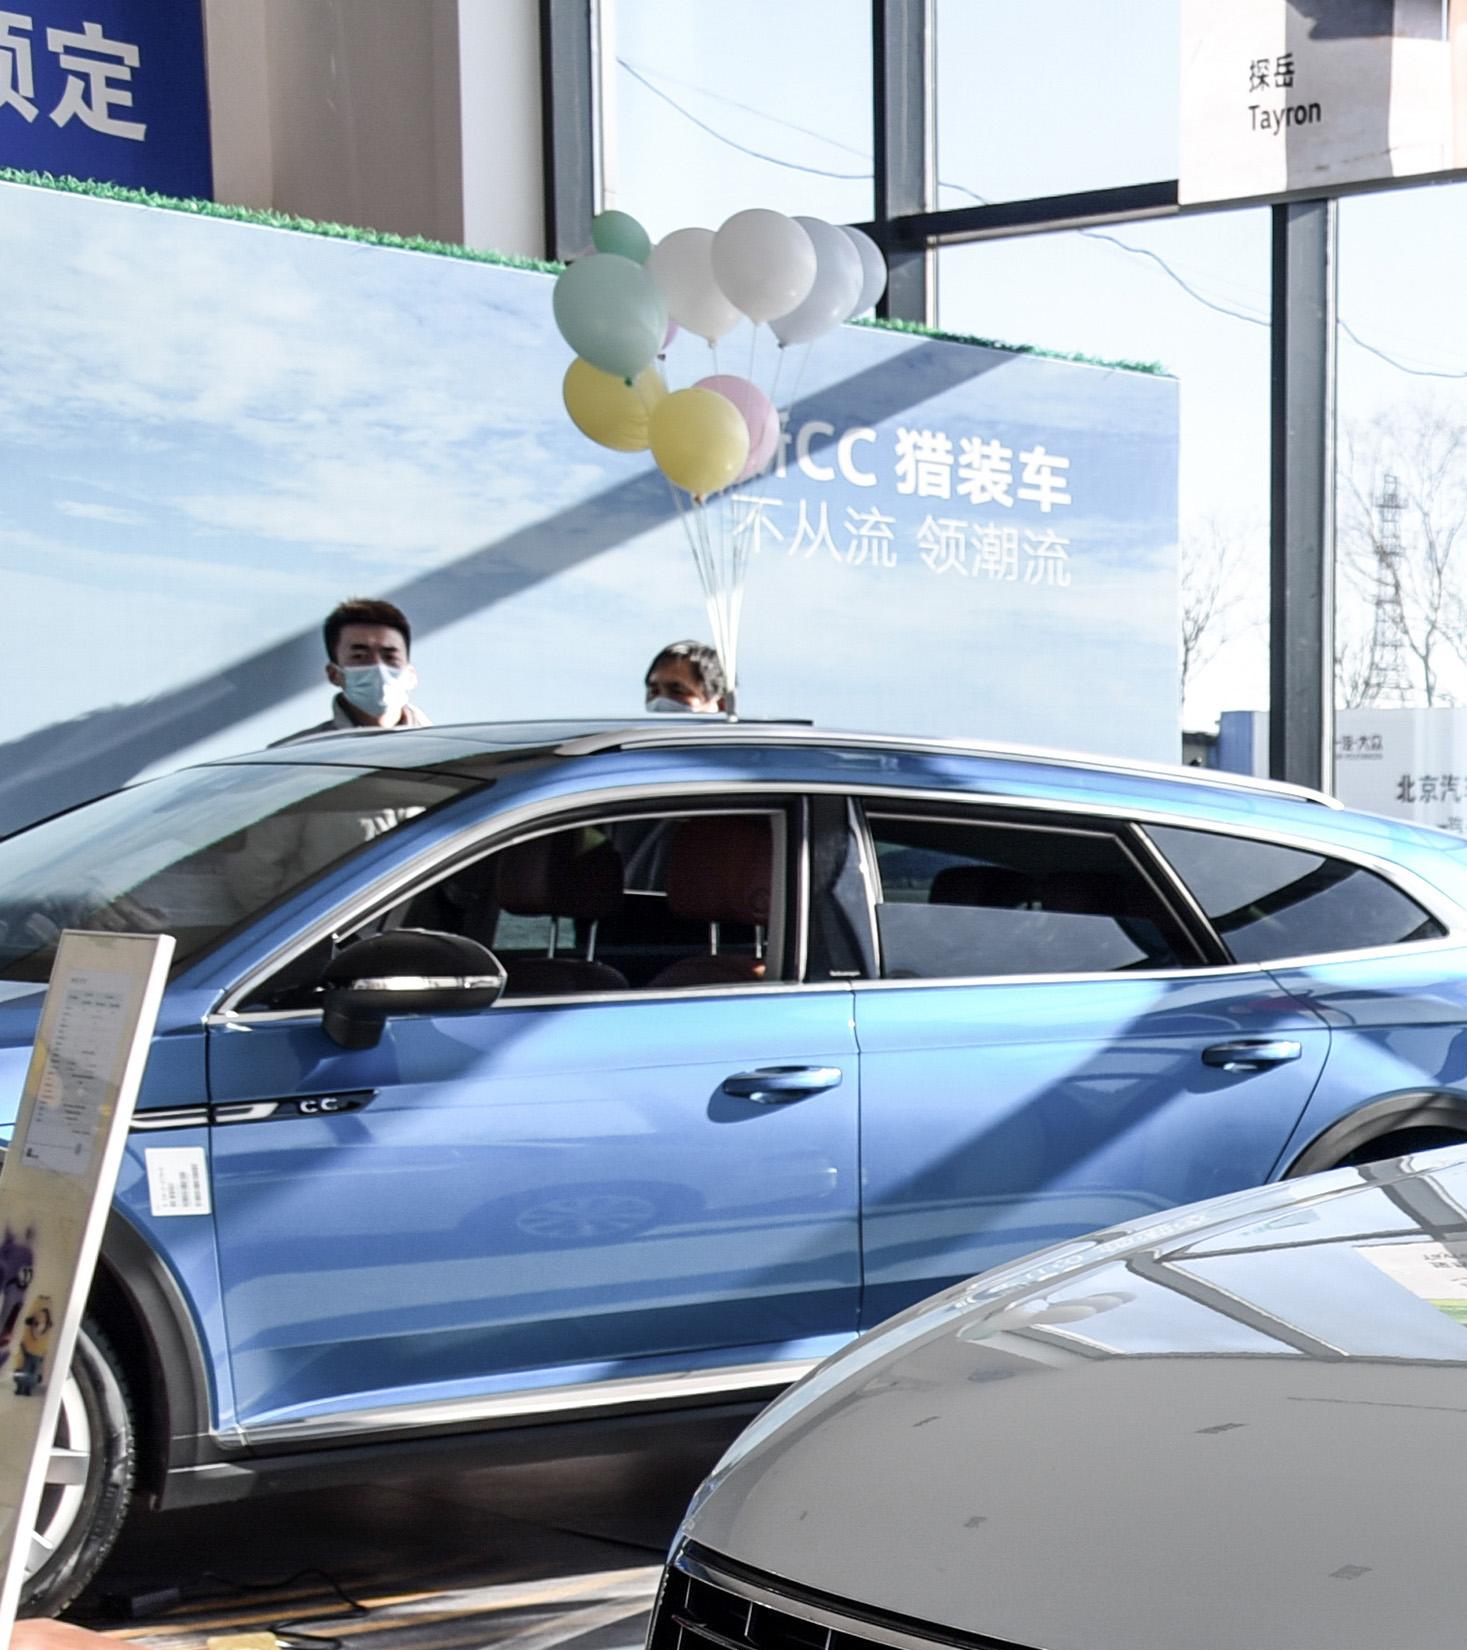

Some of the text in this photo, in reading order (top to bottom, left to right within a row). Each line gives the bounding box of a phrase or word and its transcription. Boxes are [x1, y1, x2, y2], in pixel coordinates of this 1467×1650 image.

[1248, 52, 1296, 93] 探岳
[1247, 102, 1322, 136] Tayron
[894, 426, 1072, 514] 猎装车
[730, 492, 1072, 588] 不从流 领潮流
[299, 1097, 339, 1114] CC
